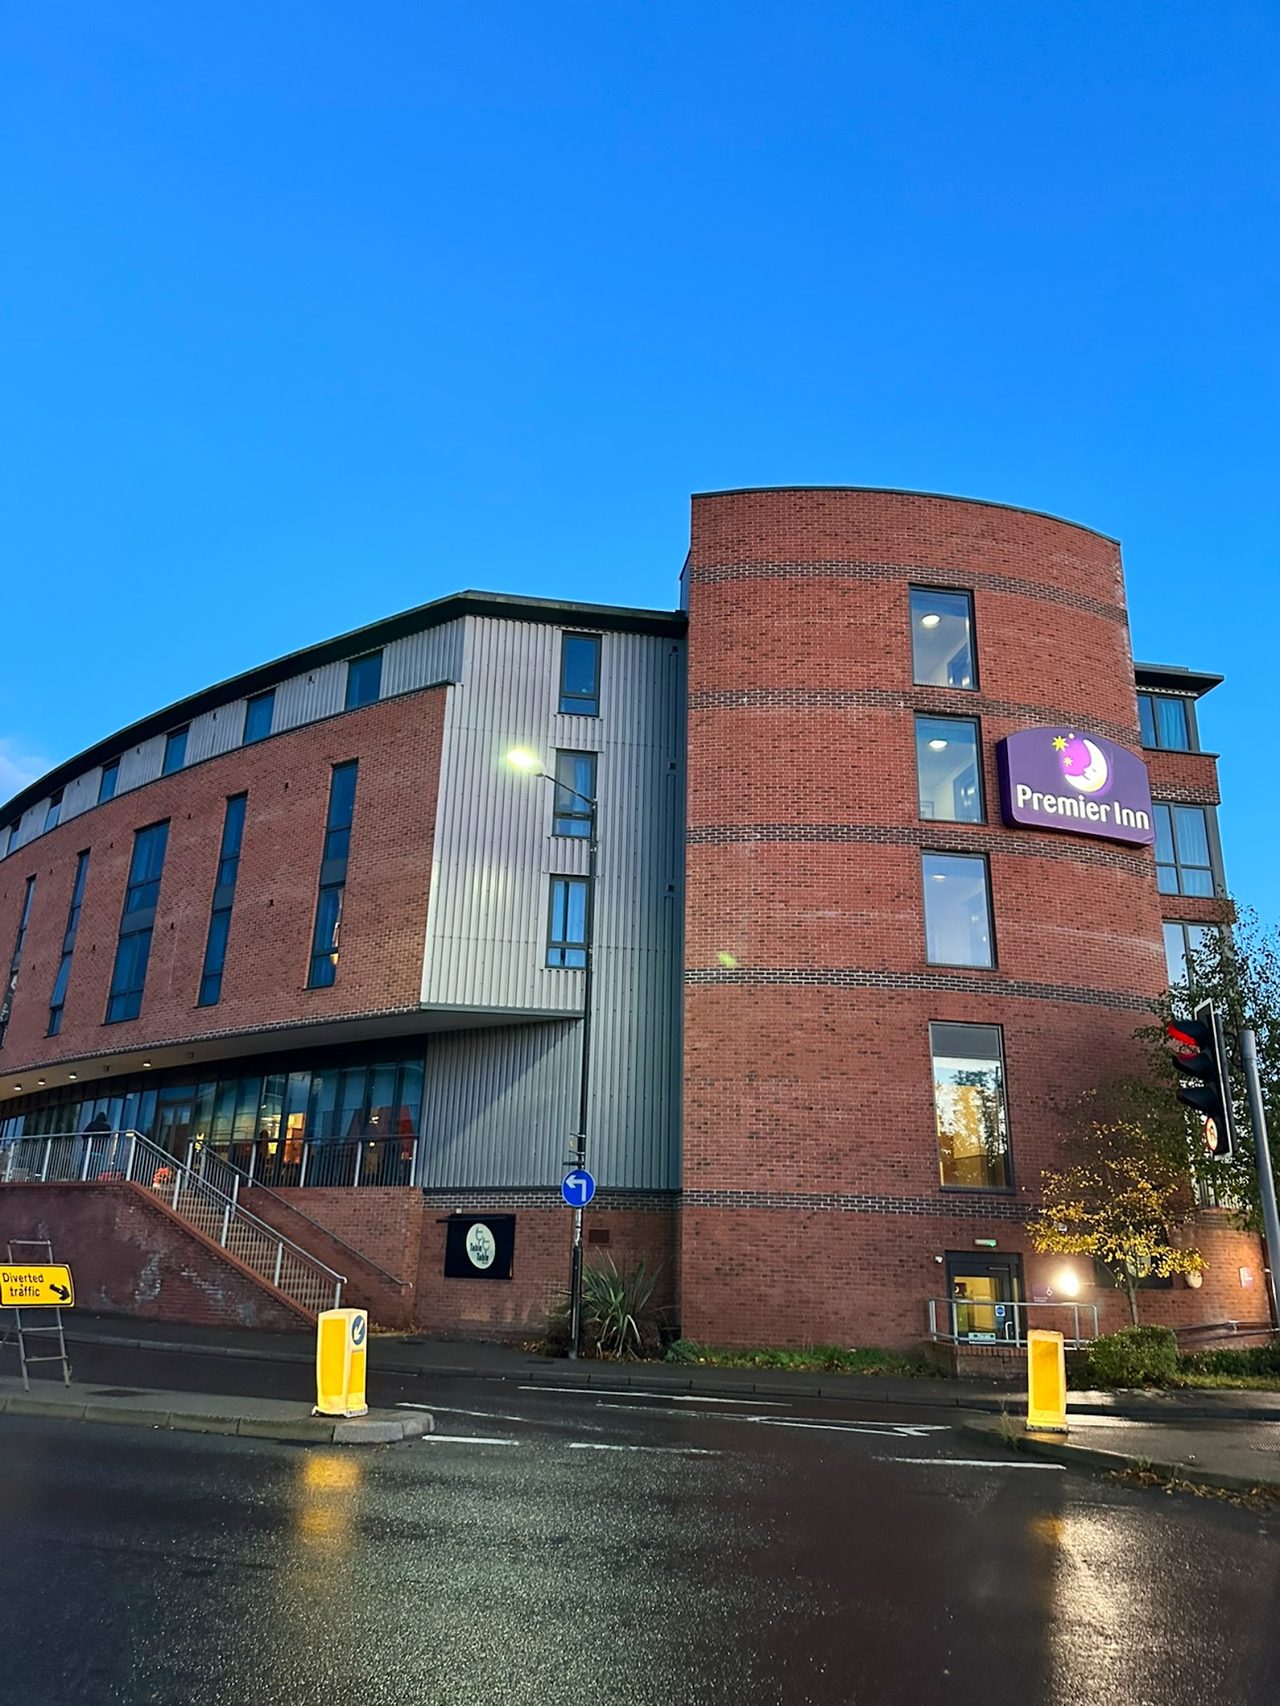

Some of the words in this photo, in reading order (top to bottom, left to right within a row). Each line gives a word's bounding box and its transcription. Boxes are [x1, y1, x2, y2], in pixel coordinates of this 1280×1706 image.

[1016, 784, 1111, 822] Premier
[1114, 801, 1150, 830] Inn
[2, 1272, 44, 1283] Diverted
[10, 1286, 41, 1297] traffic
